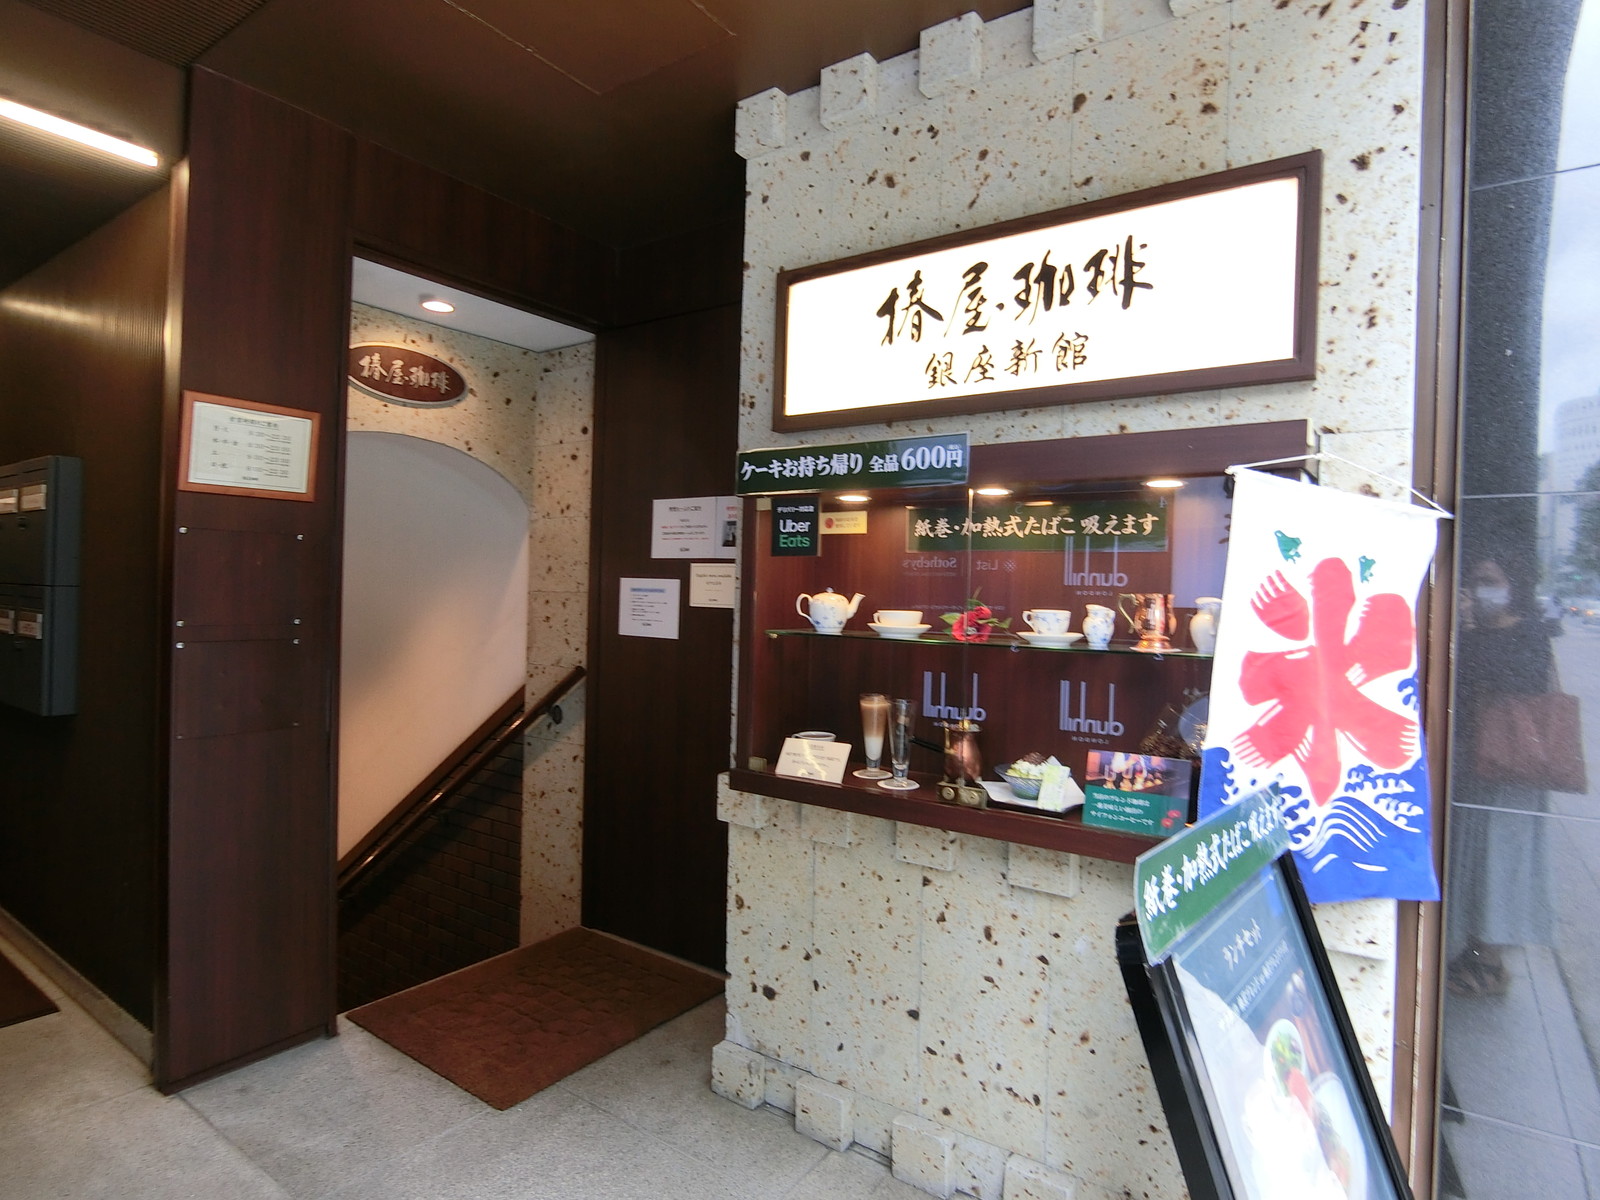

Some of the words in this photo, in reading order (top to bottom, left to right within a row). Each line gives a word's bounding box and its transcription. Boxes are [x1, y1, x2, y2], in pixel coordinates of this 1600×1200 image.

[925, 332, 1089, 389] 銀座新館
[740, 452, 863, 481] ケーキお持ち帰り
[779, 519, 811, 533] Uber
[1080, 512, 1160, 536] 吸えます
[779, 534, 811, 548] Eats
